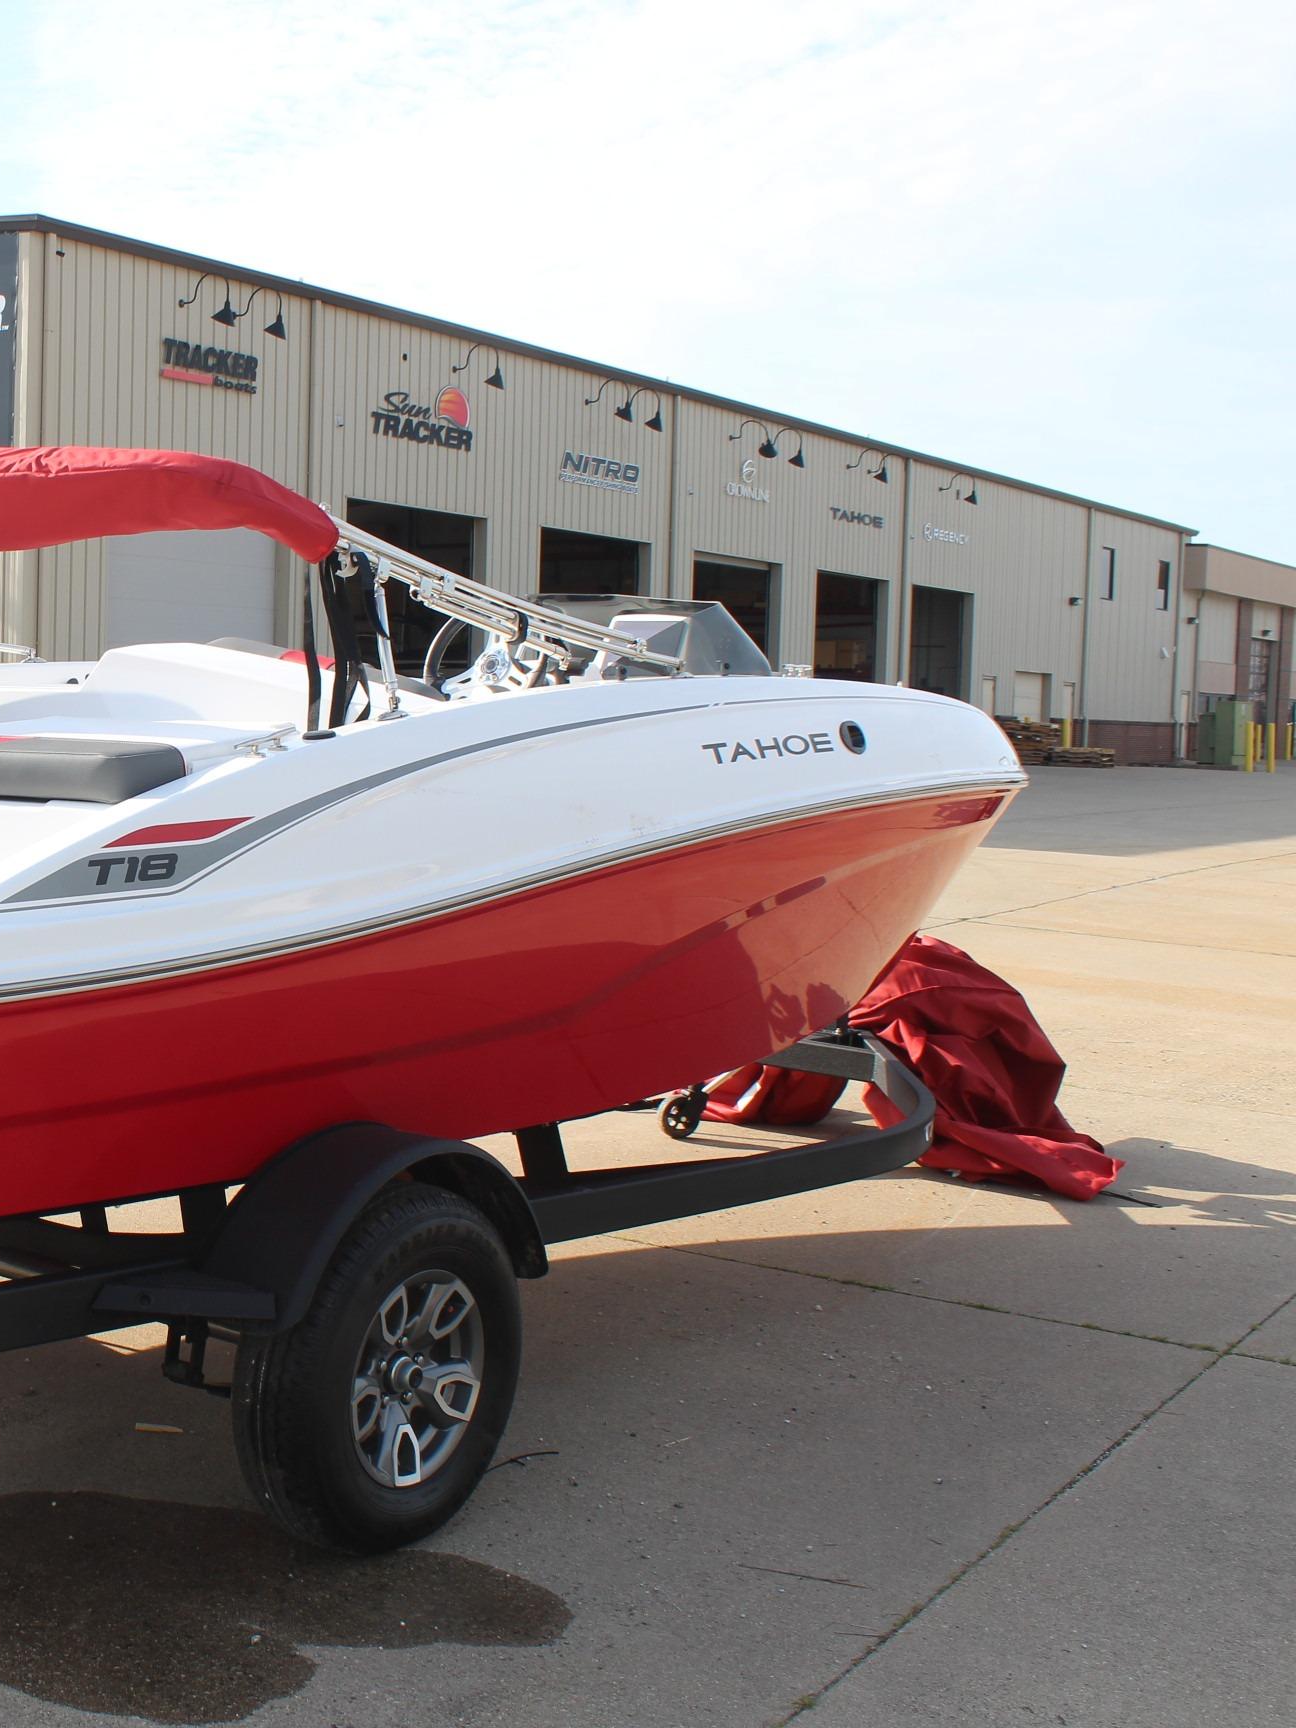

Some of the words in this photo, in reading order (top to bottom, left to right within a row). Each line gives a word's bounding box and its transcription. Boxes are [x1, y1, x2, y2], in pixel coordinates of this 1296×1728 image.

[163, 338, 258, 382] TRACKER
[214, 375, 257, 394] boats
[377, 391, 433, 420] Sun
[371, 411, 473, 452] TRACKER
[561, 450, 640, 484] NITRO
[830, 506, 885, 529] TAHOE
[701, 732, 835, 765] TAHOE
[87, 852, 179, 886] T18
